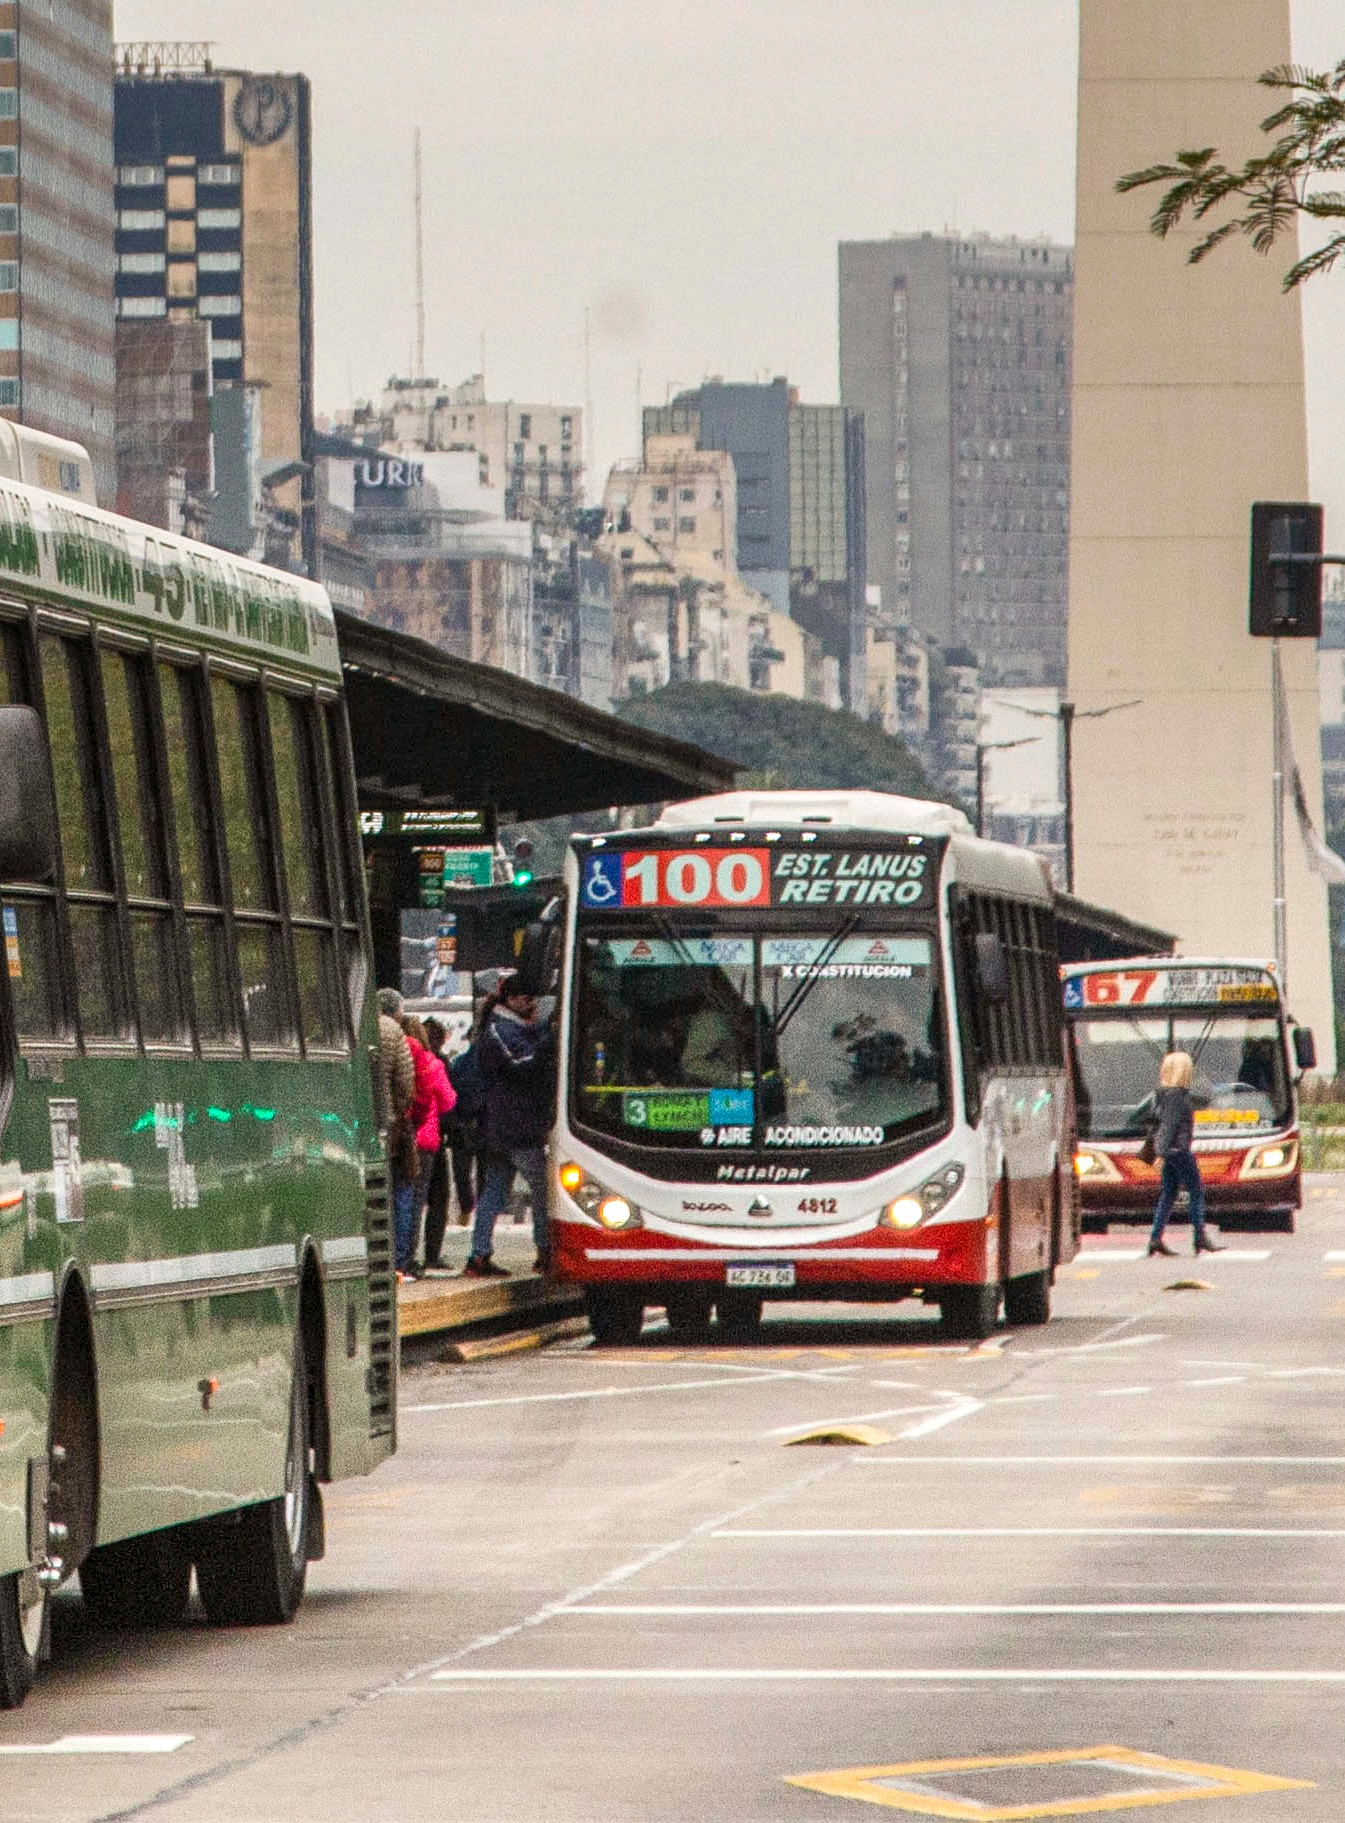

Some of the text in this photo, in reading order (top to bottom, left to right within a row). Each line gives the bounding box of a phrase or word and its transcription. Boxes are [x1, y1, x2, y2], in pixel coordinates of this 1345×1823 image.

[774, 854, 927, 878] EST. LANUS
[625, 853, 764, 904] 100
[779, 878, 924, 905] RETIRO
[1084, 970, 1158, 1004] 67
[628, 1100, 647, 1124] 3
[717, 1126, 885, 1146] AIRE ACONDICIONADO
[717, 1165, 811, 1182] Metalpar
[798, 1198, 838, 1214] 4812
